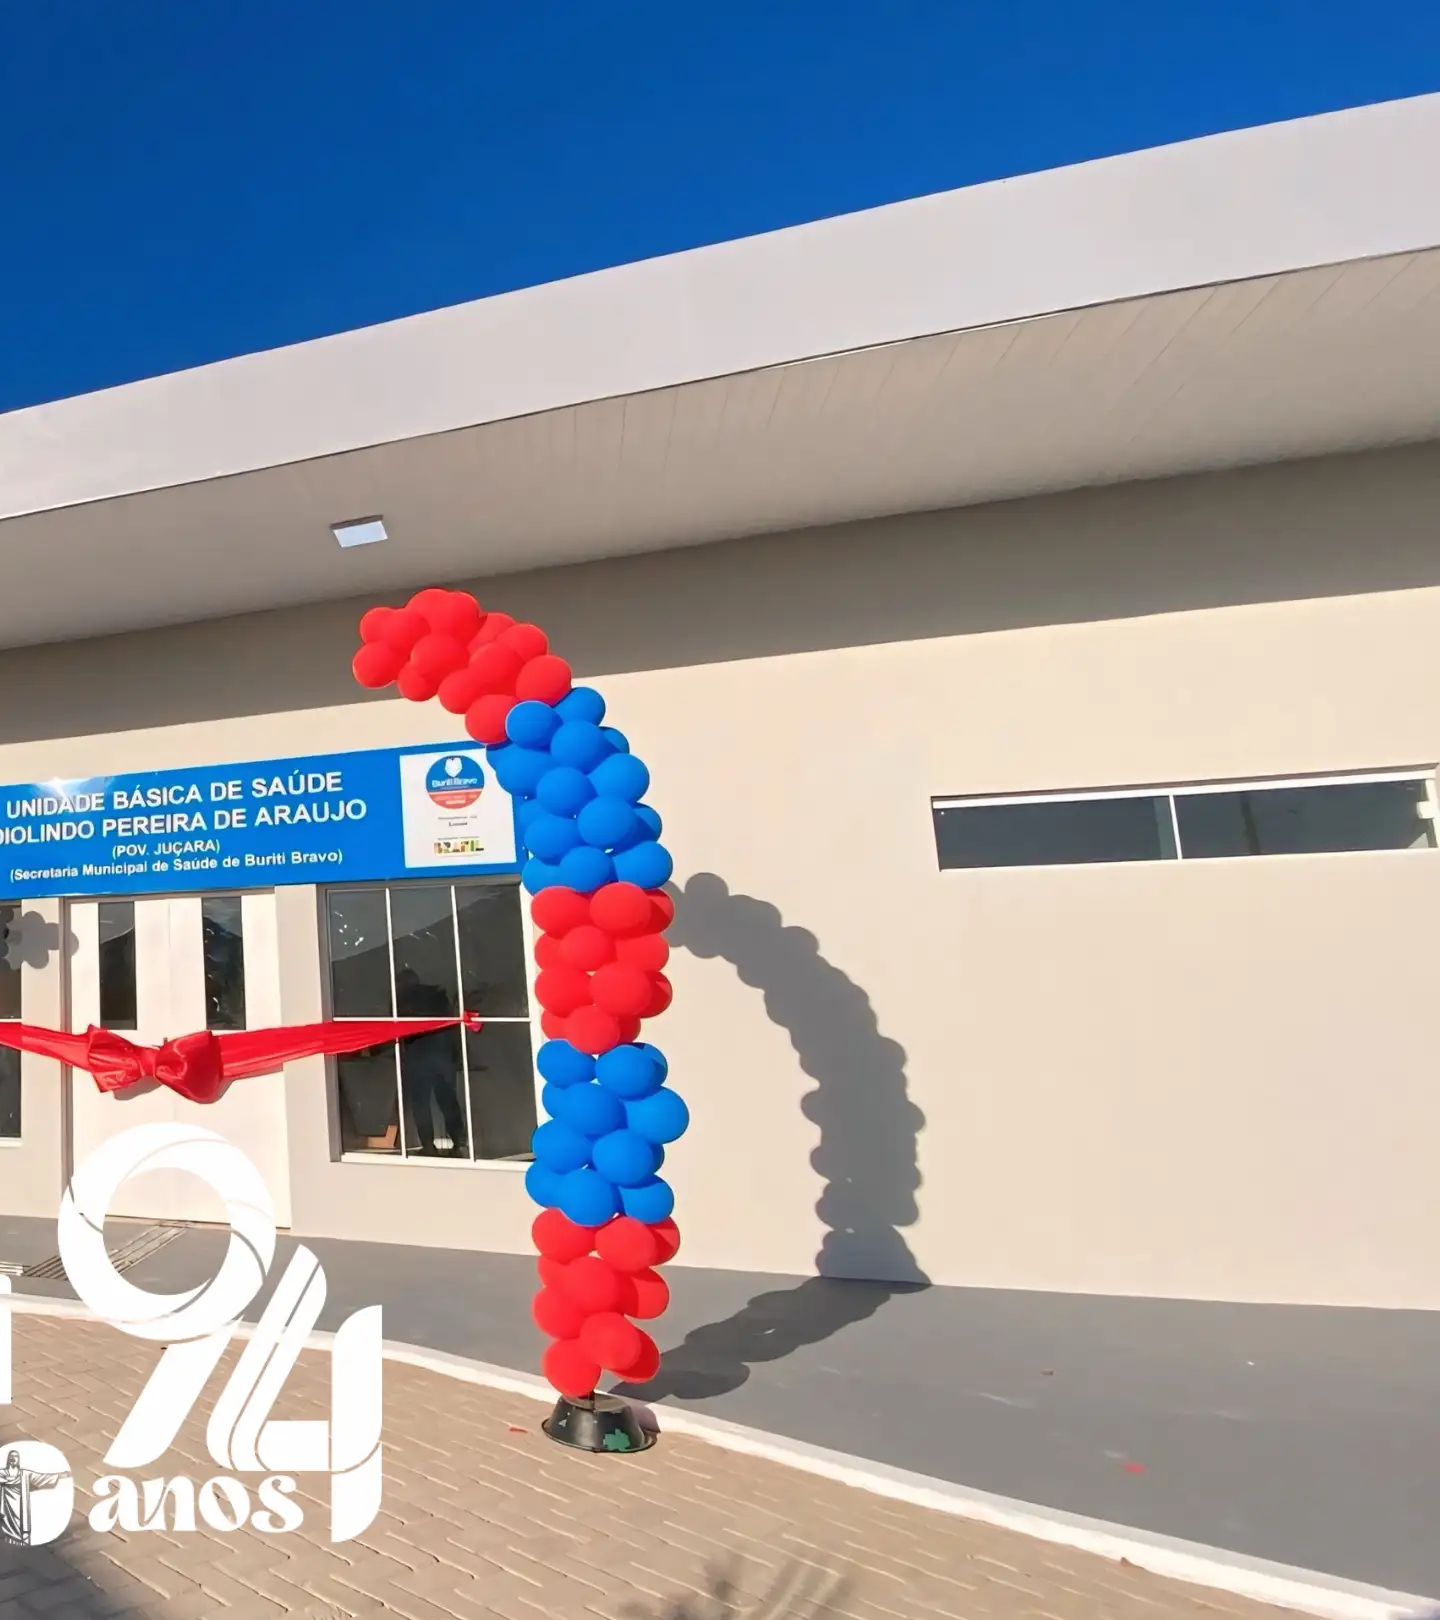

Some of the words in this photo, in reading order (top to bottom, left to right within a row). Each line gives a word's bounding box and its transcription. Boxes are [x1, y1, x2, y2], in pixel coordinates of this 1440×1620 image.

[6, 793, 106, 819] UNIDADE
[113, 784, 203, 810] BÁSICA
[210, 780, 244, 802] DE
[251, 769, 343, 798] SAÚDE
[102, 812, 207, 838] PEREIRA
[214, 808, 248, 830] DE
[254, 799, 367, 827] ARAUJO
[10, 865, 79, 883] (Secretaria
[82, 861, 148, 877] Municipal
[152, 860, 168, 873] de
[173, 857, 218, 872] Saúde
[222, 855, 240, 868] de
[244, 852, 286, 867] Buriti
[291, 849, 343, 864] Bravo)
[112, 844, 150, 860] (POV.
[153, 839, 220, 857] JUÇARA)
